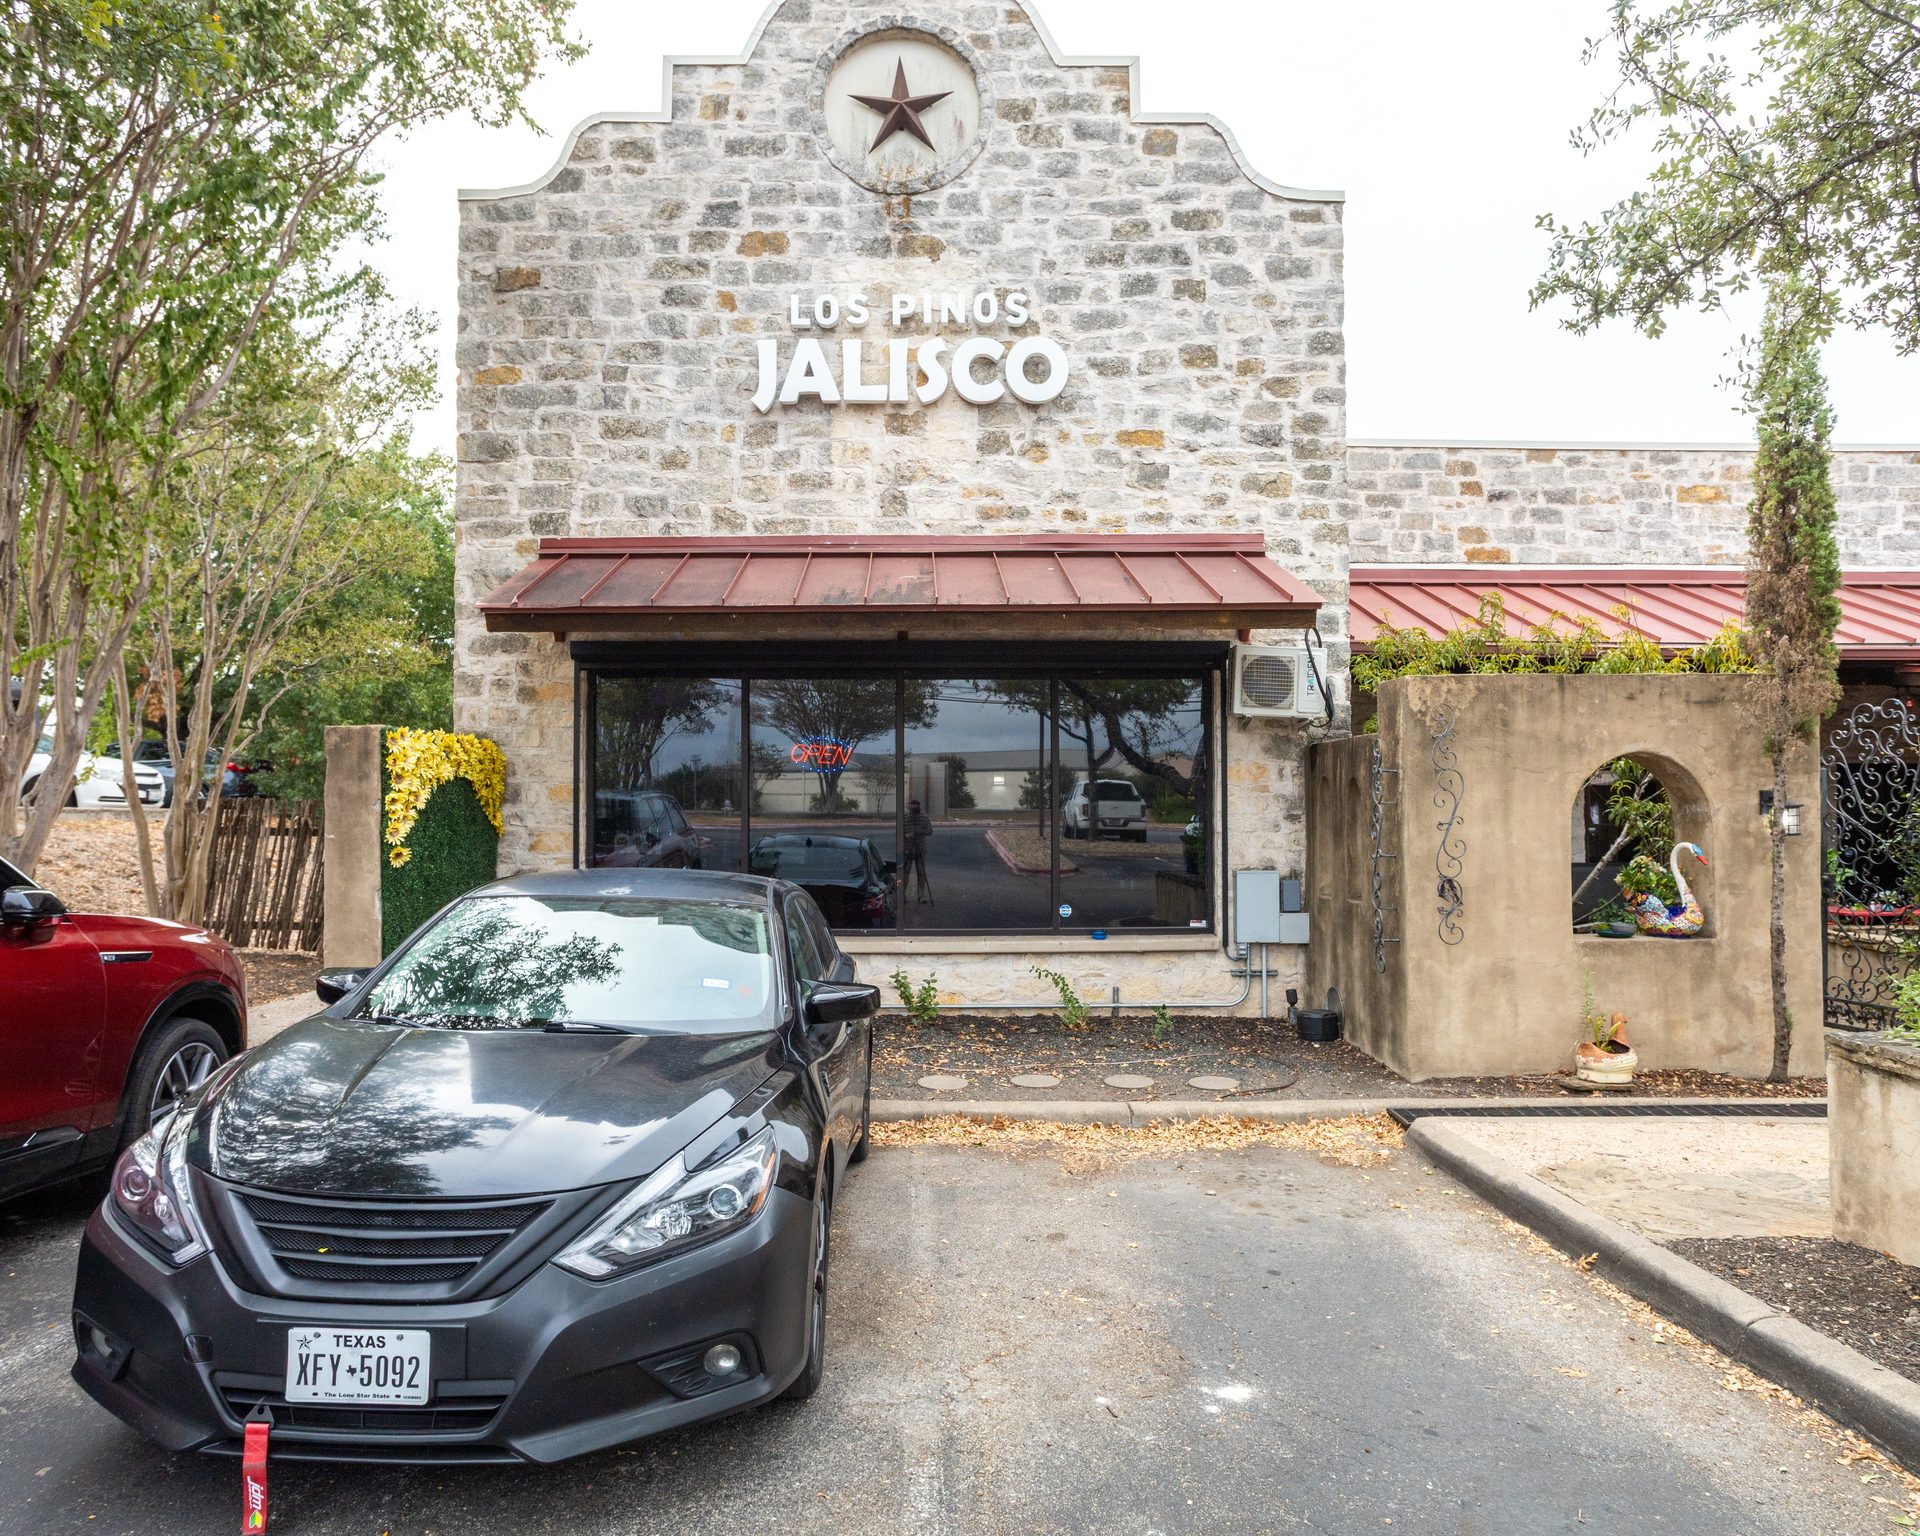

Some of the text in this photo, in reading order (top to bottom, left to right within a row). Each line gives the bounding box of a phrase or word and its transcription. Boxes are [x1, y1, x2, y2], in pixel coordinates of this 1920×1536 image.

[790, 292, 1029, 329] LOS PINOS
[751, 336, 1070, 414] JALISCO
[790, 743, 853, 766] OPEN
[333, 1334, 386, 1349] TEXAS
[296, 1352, 420, 1389] XFY 5092
